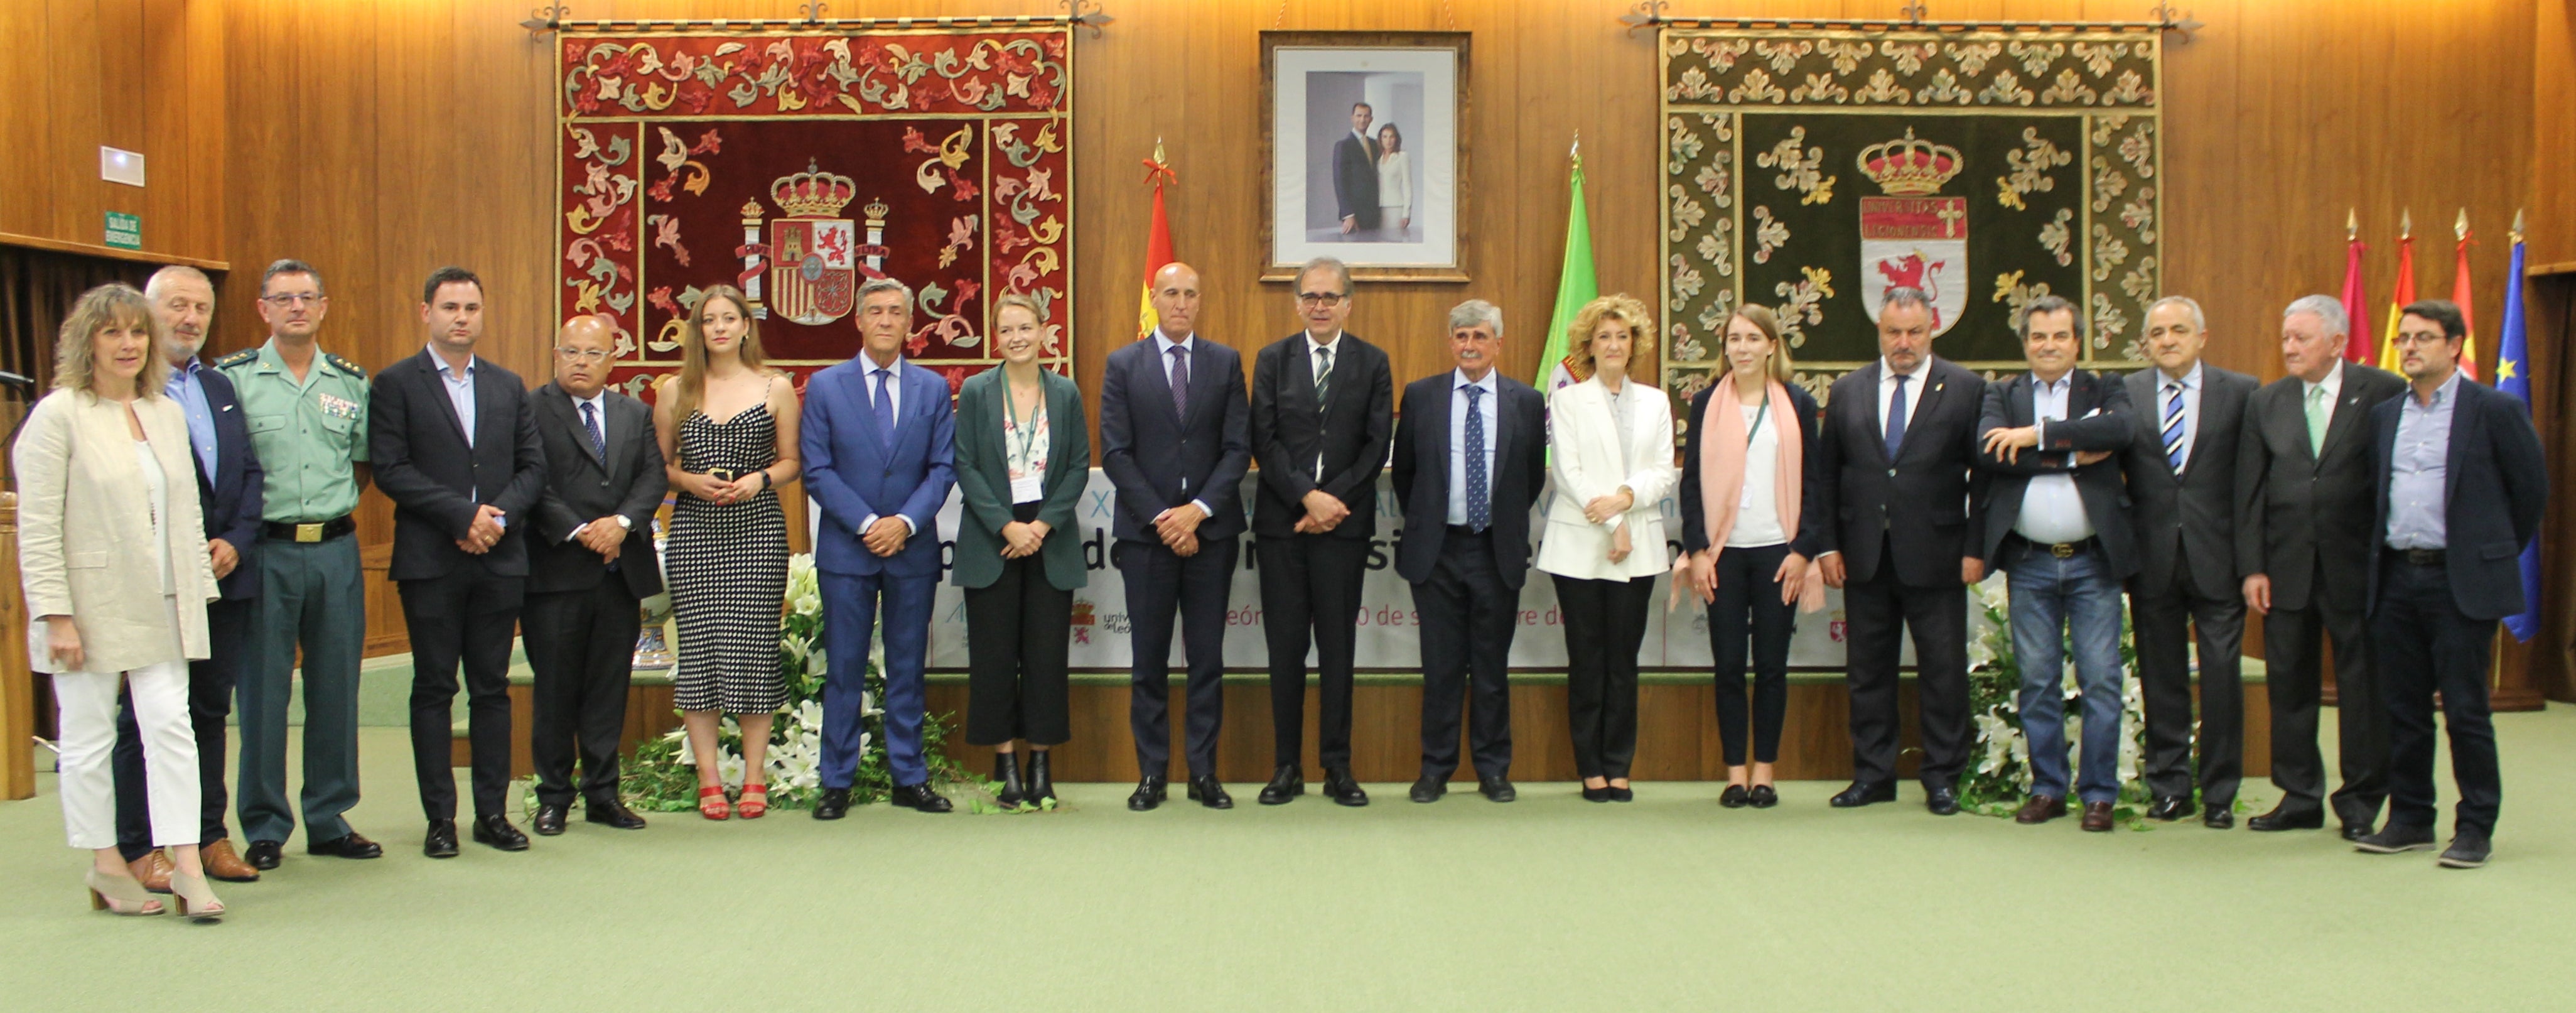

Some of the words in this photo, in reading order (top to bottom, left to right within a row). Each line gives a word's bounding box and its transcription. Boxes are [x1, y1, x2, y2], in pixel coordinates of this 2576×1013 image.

[109, 217, 129, 230] SALIDA
[129, 220, 137, 232] DE
[105, 230, 140, 246] EMERGENCIA
[1226, 604, 1264, 626] eón
[1376, 604, 1403, 626] de
